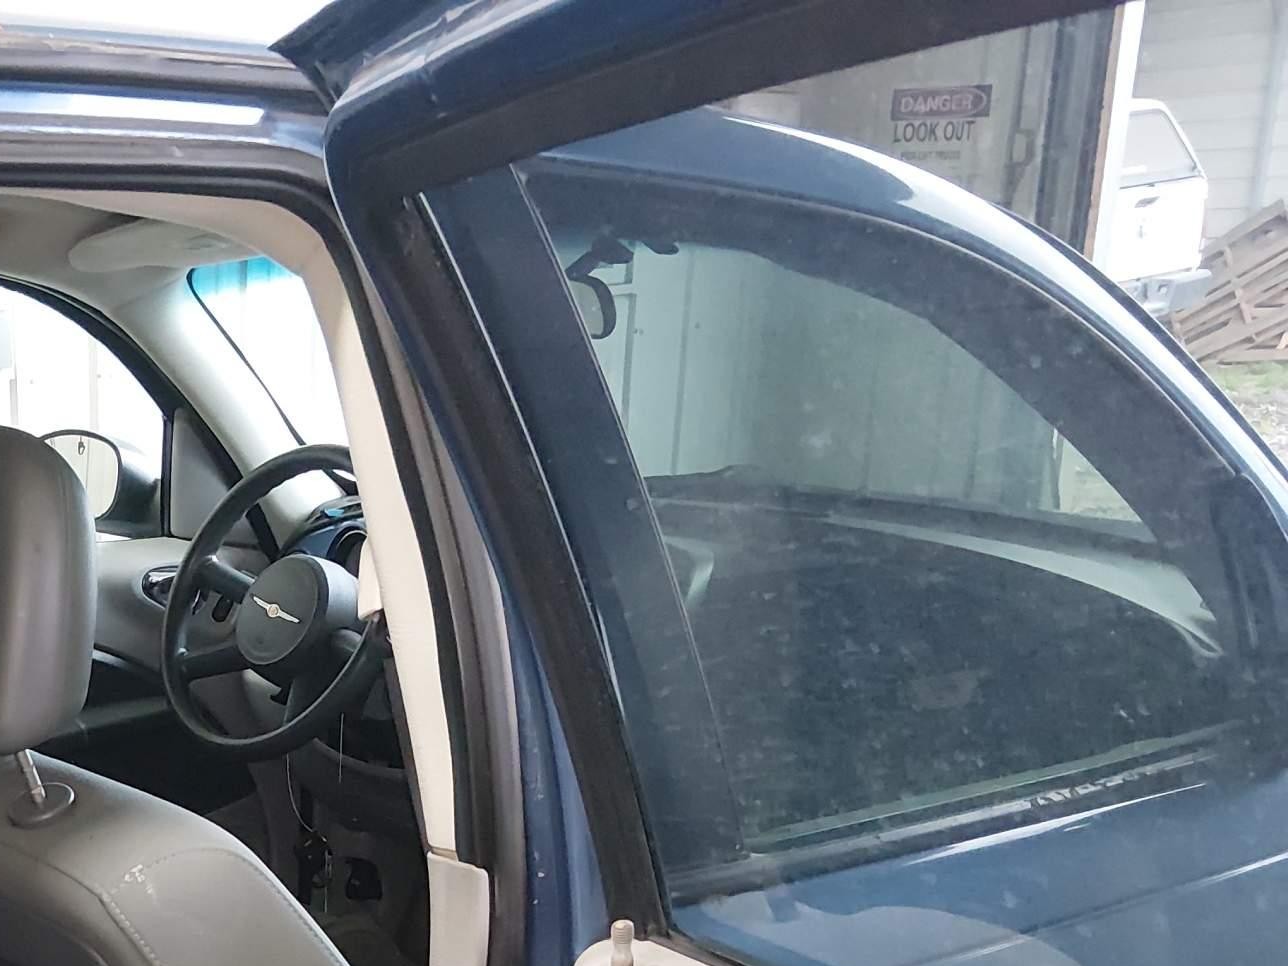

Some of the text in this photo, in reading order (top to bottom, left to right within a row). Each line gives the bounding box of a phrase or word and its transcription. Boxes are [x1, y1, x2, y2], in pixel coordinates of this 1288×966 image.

[899, 94, 974, 113] DANGER
[893, 120, 976, 143] LOOK OUT
